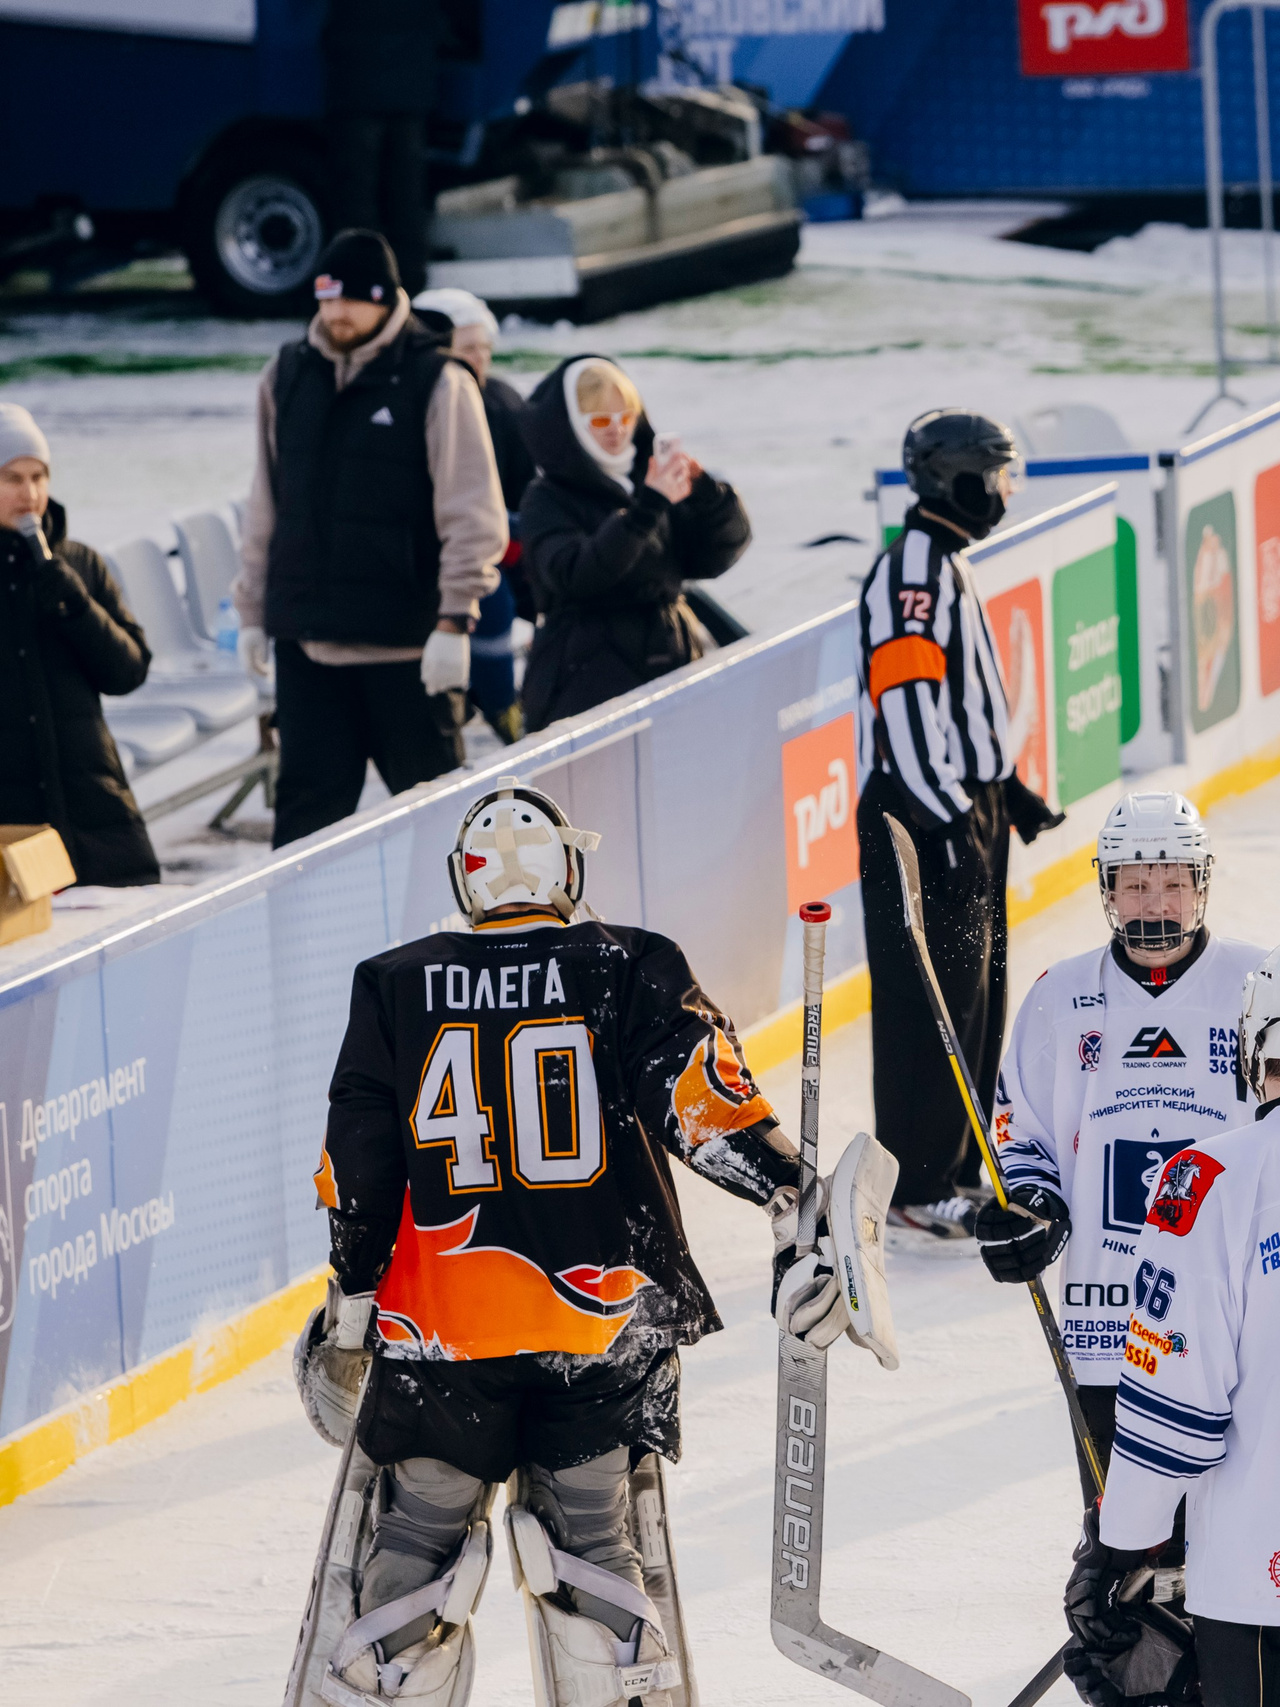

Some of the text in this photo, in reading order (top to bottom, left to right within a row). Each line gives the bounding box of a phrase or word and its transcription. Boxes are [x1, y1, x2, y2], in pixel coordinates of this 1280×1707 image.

[898, 590, 932, 621] 72
[424, 957, 566, 1011] ГОЛЕГА
[936, 1020, 953, 1055] CCM
[1209, 1027, 1240, 1043] PAN
[1152, 1061, 1187, 1069] COMPANY
[1209, 1043, 1239, 1059] RAM
[409, 1016, 607, 1195] 40
[1115, 1084, 1196, 1100] РОССИЙСКИЙ
[20, 1056, 147, 1162] Департамент
[1162, 1100, 1227, 1122] МЕДИЦИНЫ
[24, 1158, 93, 1222] спорта
[29, 1192, 175, 1299] города Москвы
[1051, 1230, 1069, 1261] CCM
[1133, 1257, 1177, 1323] 66
[1063, 1319, 1130, 1333] ЛЕДОВЫ
[1063, 1334, 1127, 1349] СЕРВИ
[1125, 1341, 1158, 1377] ssia
[779, 1393, 819, 1591] BAUER
[624, 1676, 649, 1687] CCM
